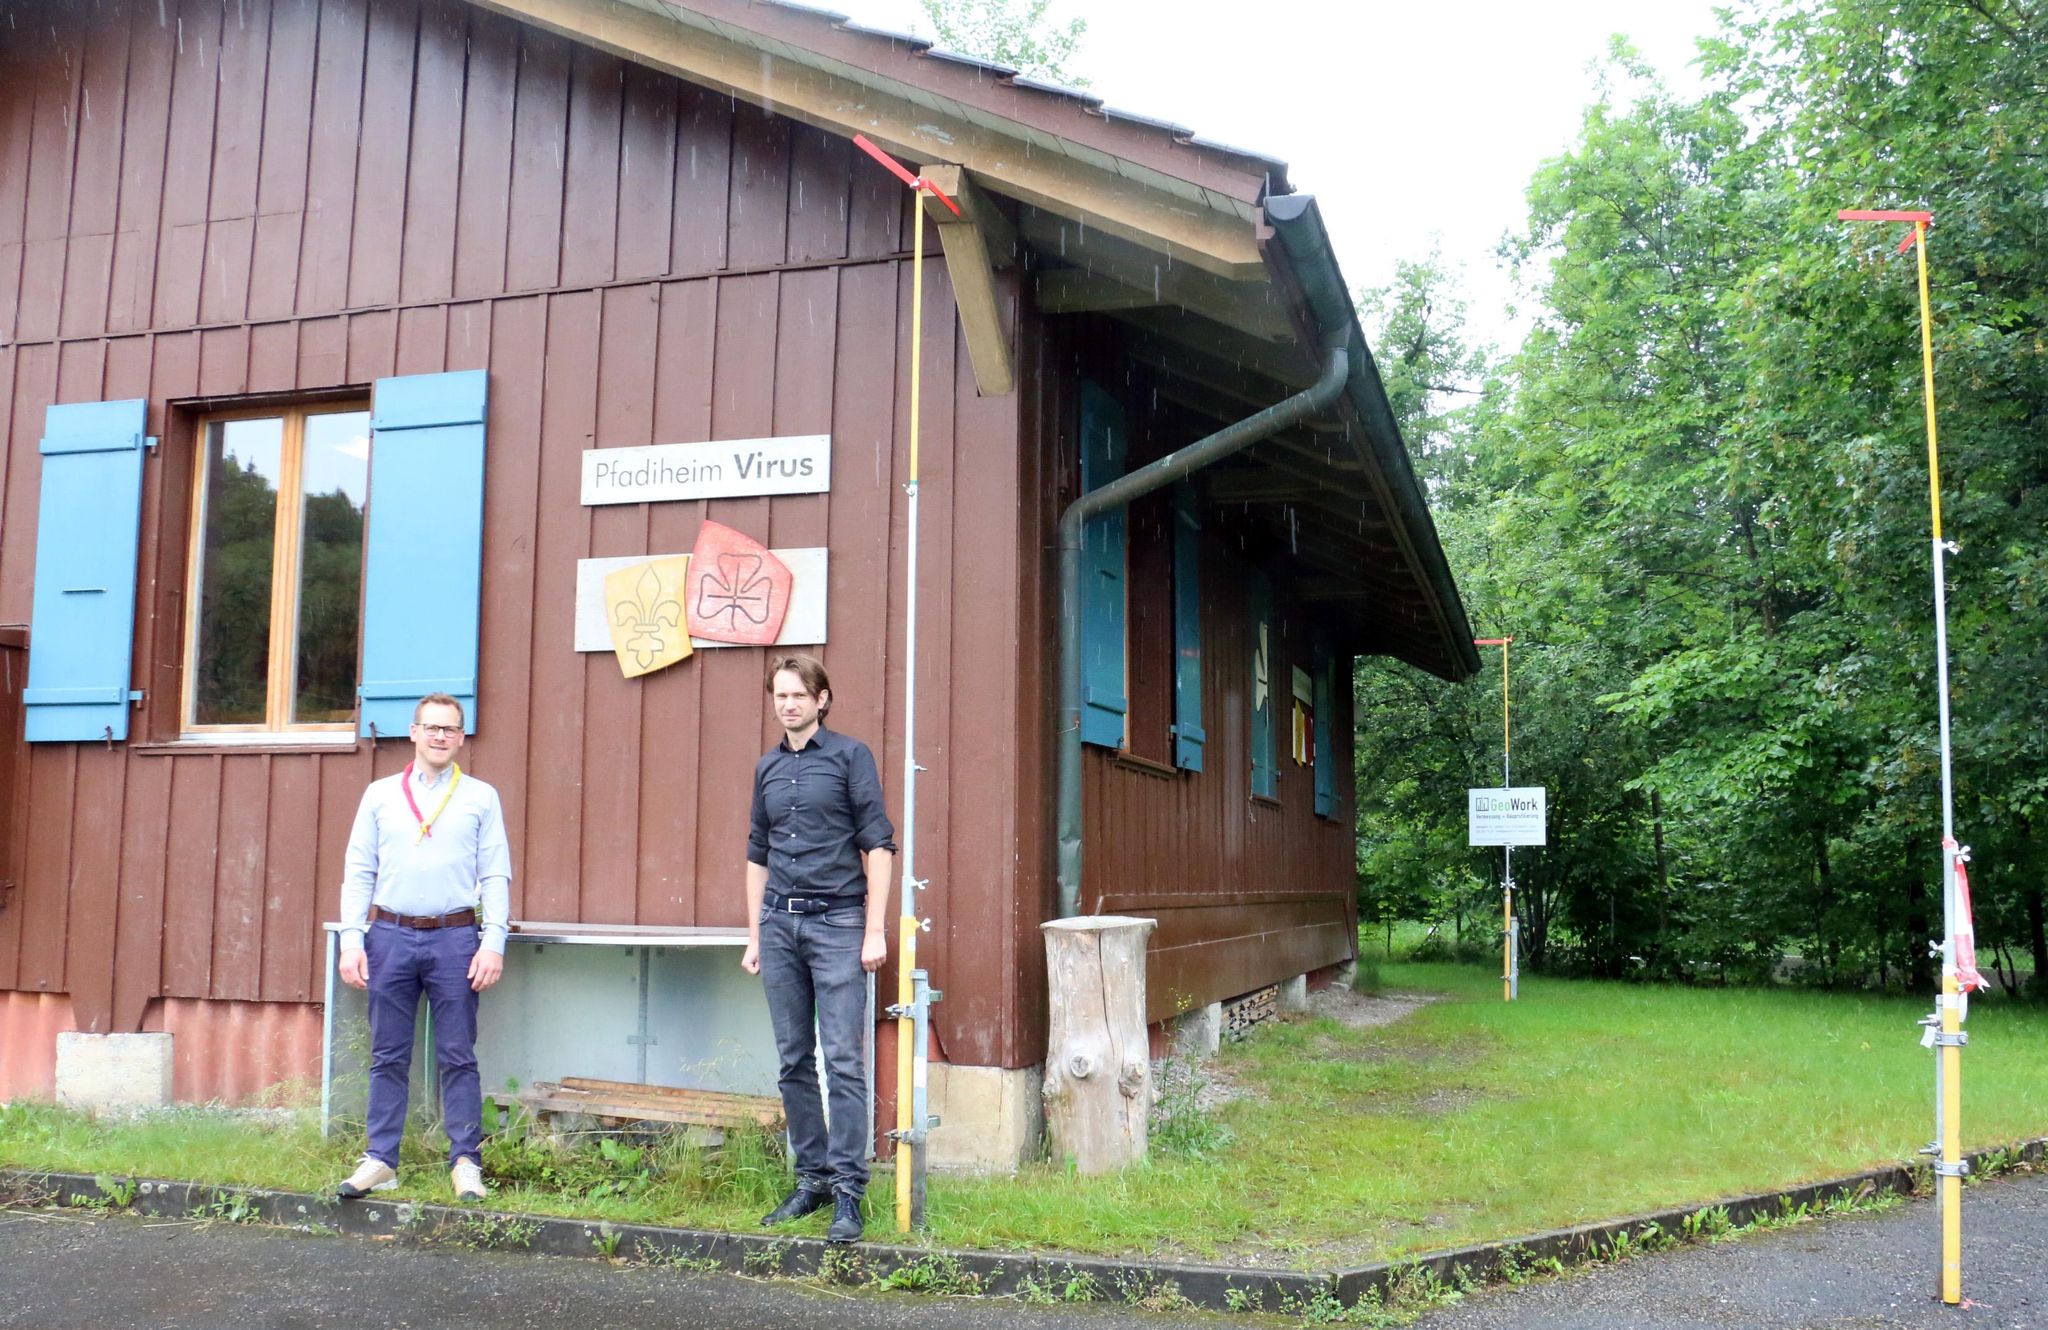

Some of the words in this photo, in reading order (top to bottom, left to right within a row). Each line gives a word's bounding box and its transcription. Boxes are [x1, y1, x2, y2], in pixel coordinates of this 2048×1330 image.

[595, 458, 722, 488] Pfadiheim
[734, 452, 814, 479] Virus
[1490, 797, 1538, 811] GeoWork
